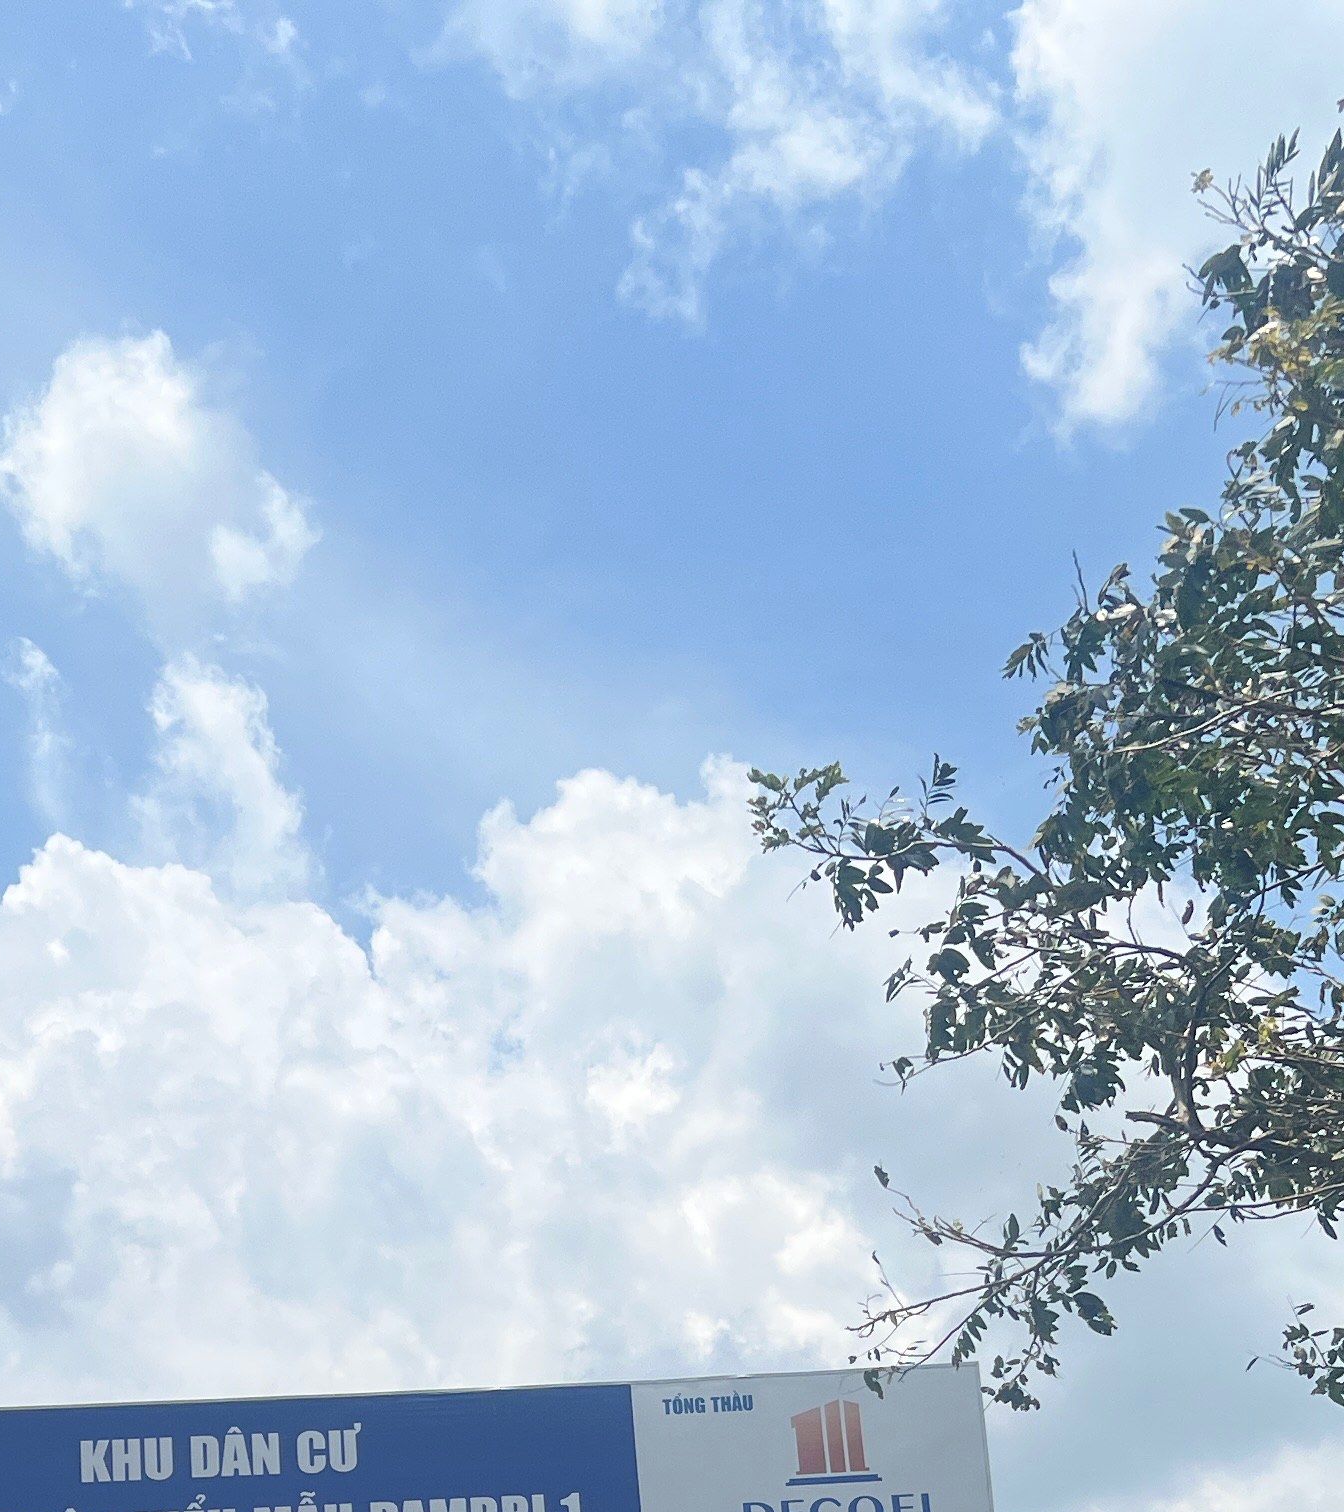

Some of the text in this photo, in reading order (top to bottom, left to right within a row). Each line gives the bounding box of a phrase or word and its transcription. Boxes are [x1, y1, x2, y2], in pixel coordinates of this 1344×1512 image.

[662, 1389, 754, 1415] TỔNG THẦU
[80, 1422, 362, 1483] KHU DÂN CƯ
